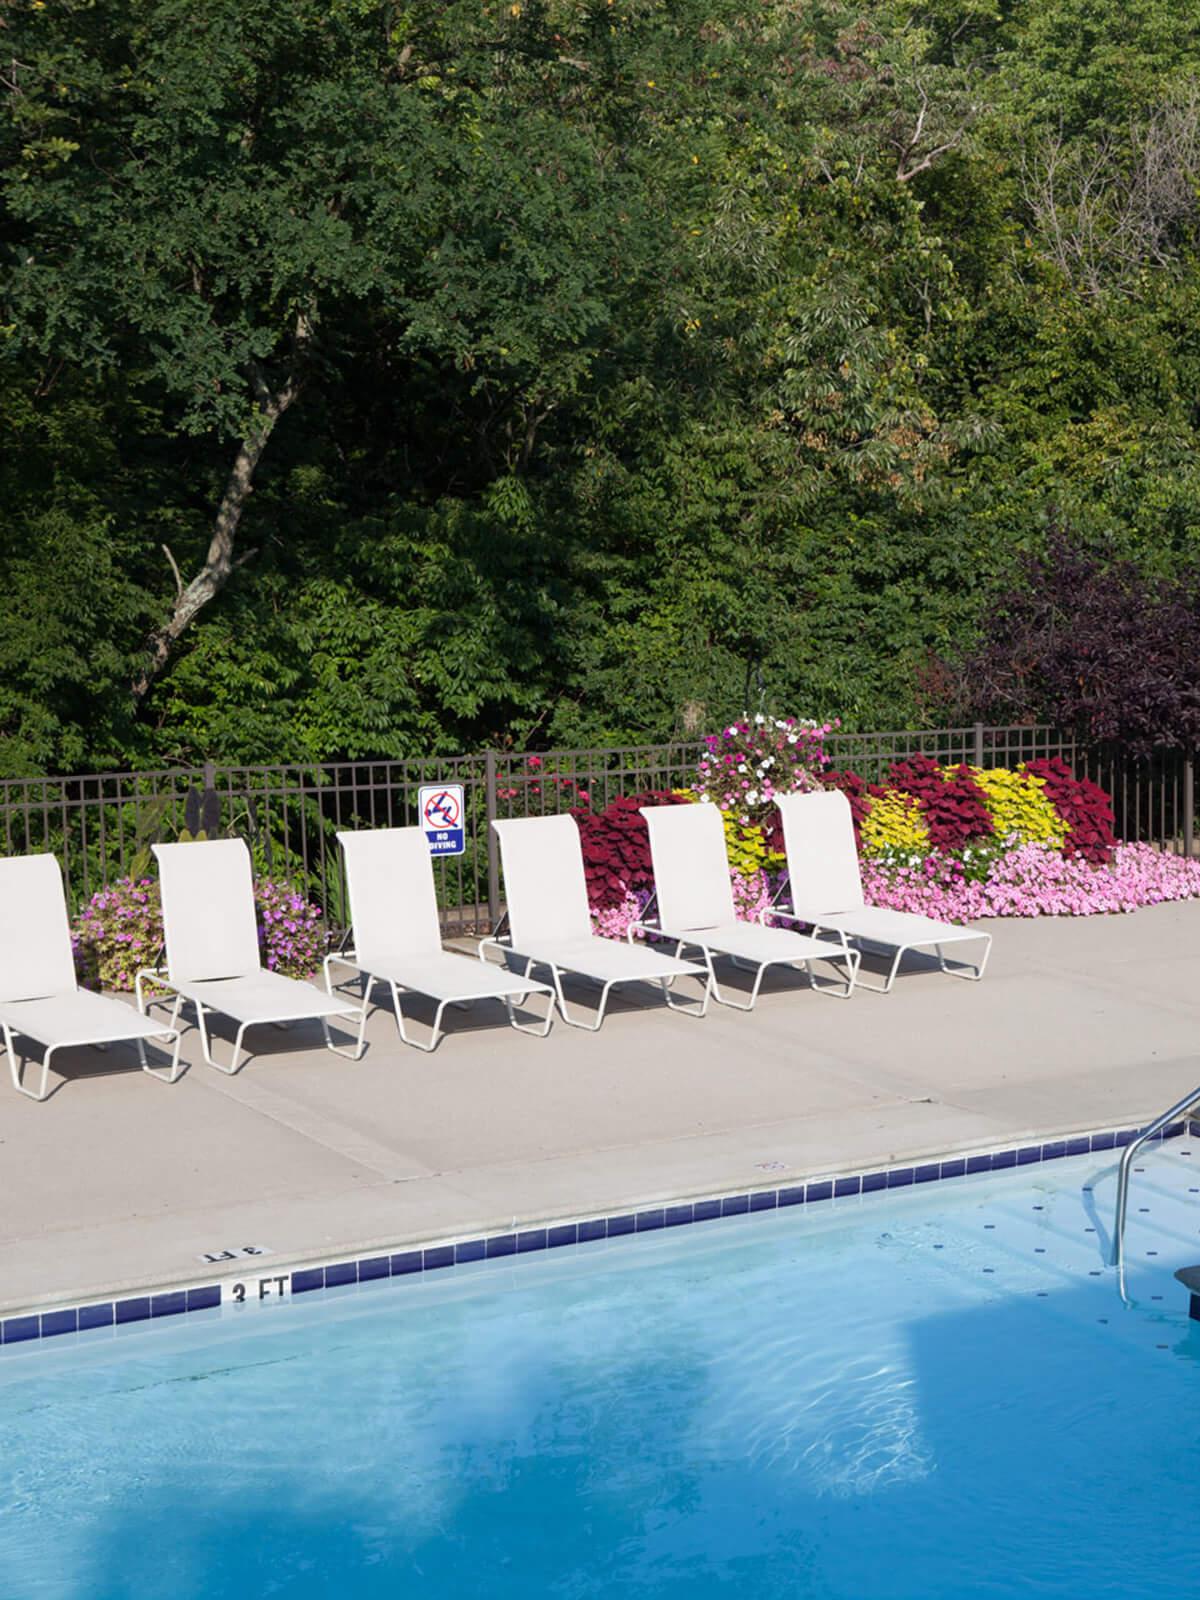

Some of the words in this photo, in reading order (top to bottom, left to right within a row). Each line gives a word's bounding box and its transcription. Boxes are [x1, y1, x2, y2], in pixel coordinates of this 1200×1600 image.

[436, 832, 448, 840] NO
[203, 1250, 237, 1263] FT
[232, 1283, 246, 1303] 3
[259, 1275, 289, 1300] FT
